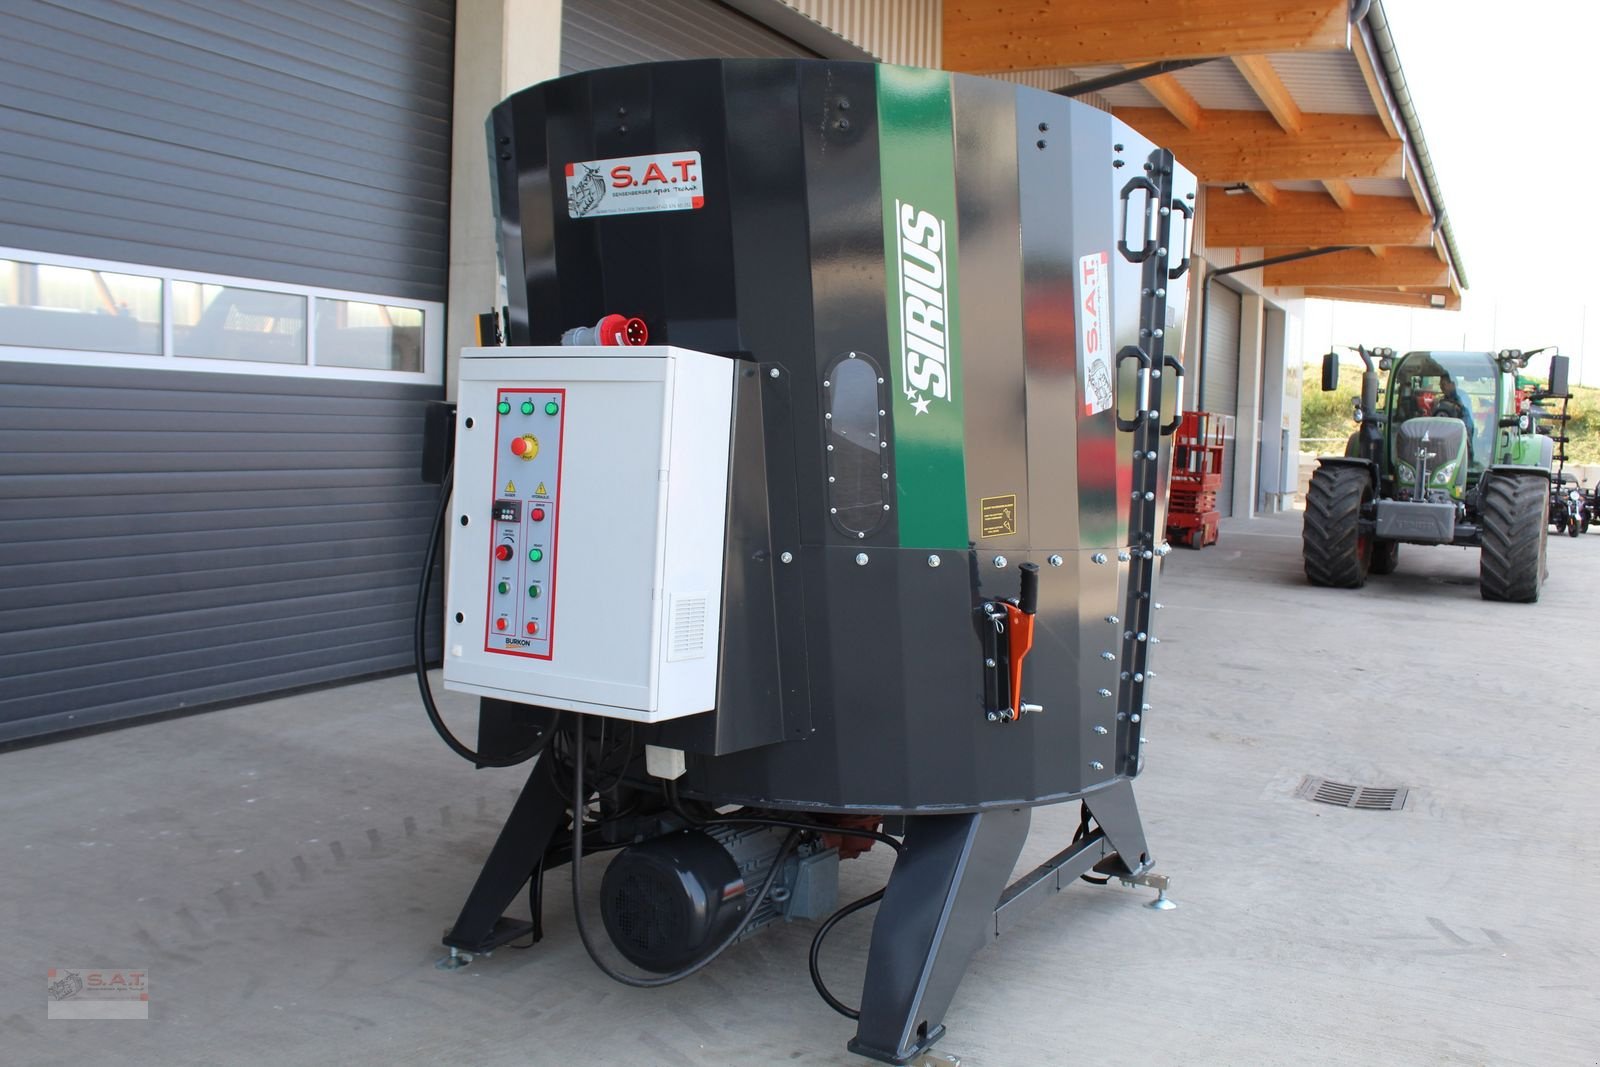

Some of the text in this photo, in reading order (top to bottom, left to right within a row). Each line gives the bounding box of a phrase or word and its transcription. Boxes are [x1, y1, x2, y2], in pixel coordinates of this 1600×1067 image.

[610, 160, 697, 188] S.A.T.
[901, 203, 946, 398] SIRIUS
[1083, 259, 1099, 354] S.A.T.
[505, 638, 531, 647] BURKON
